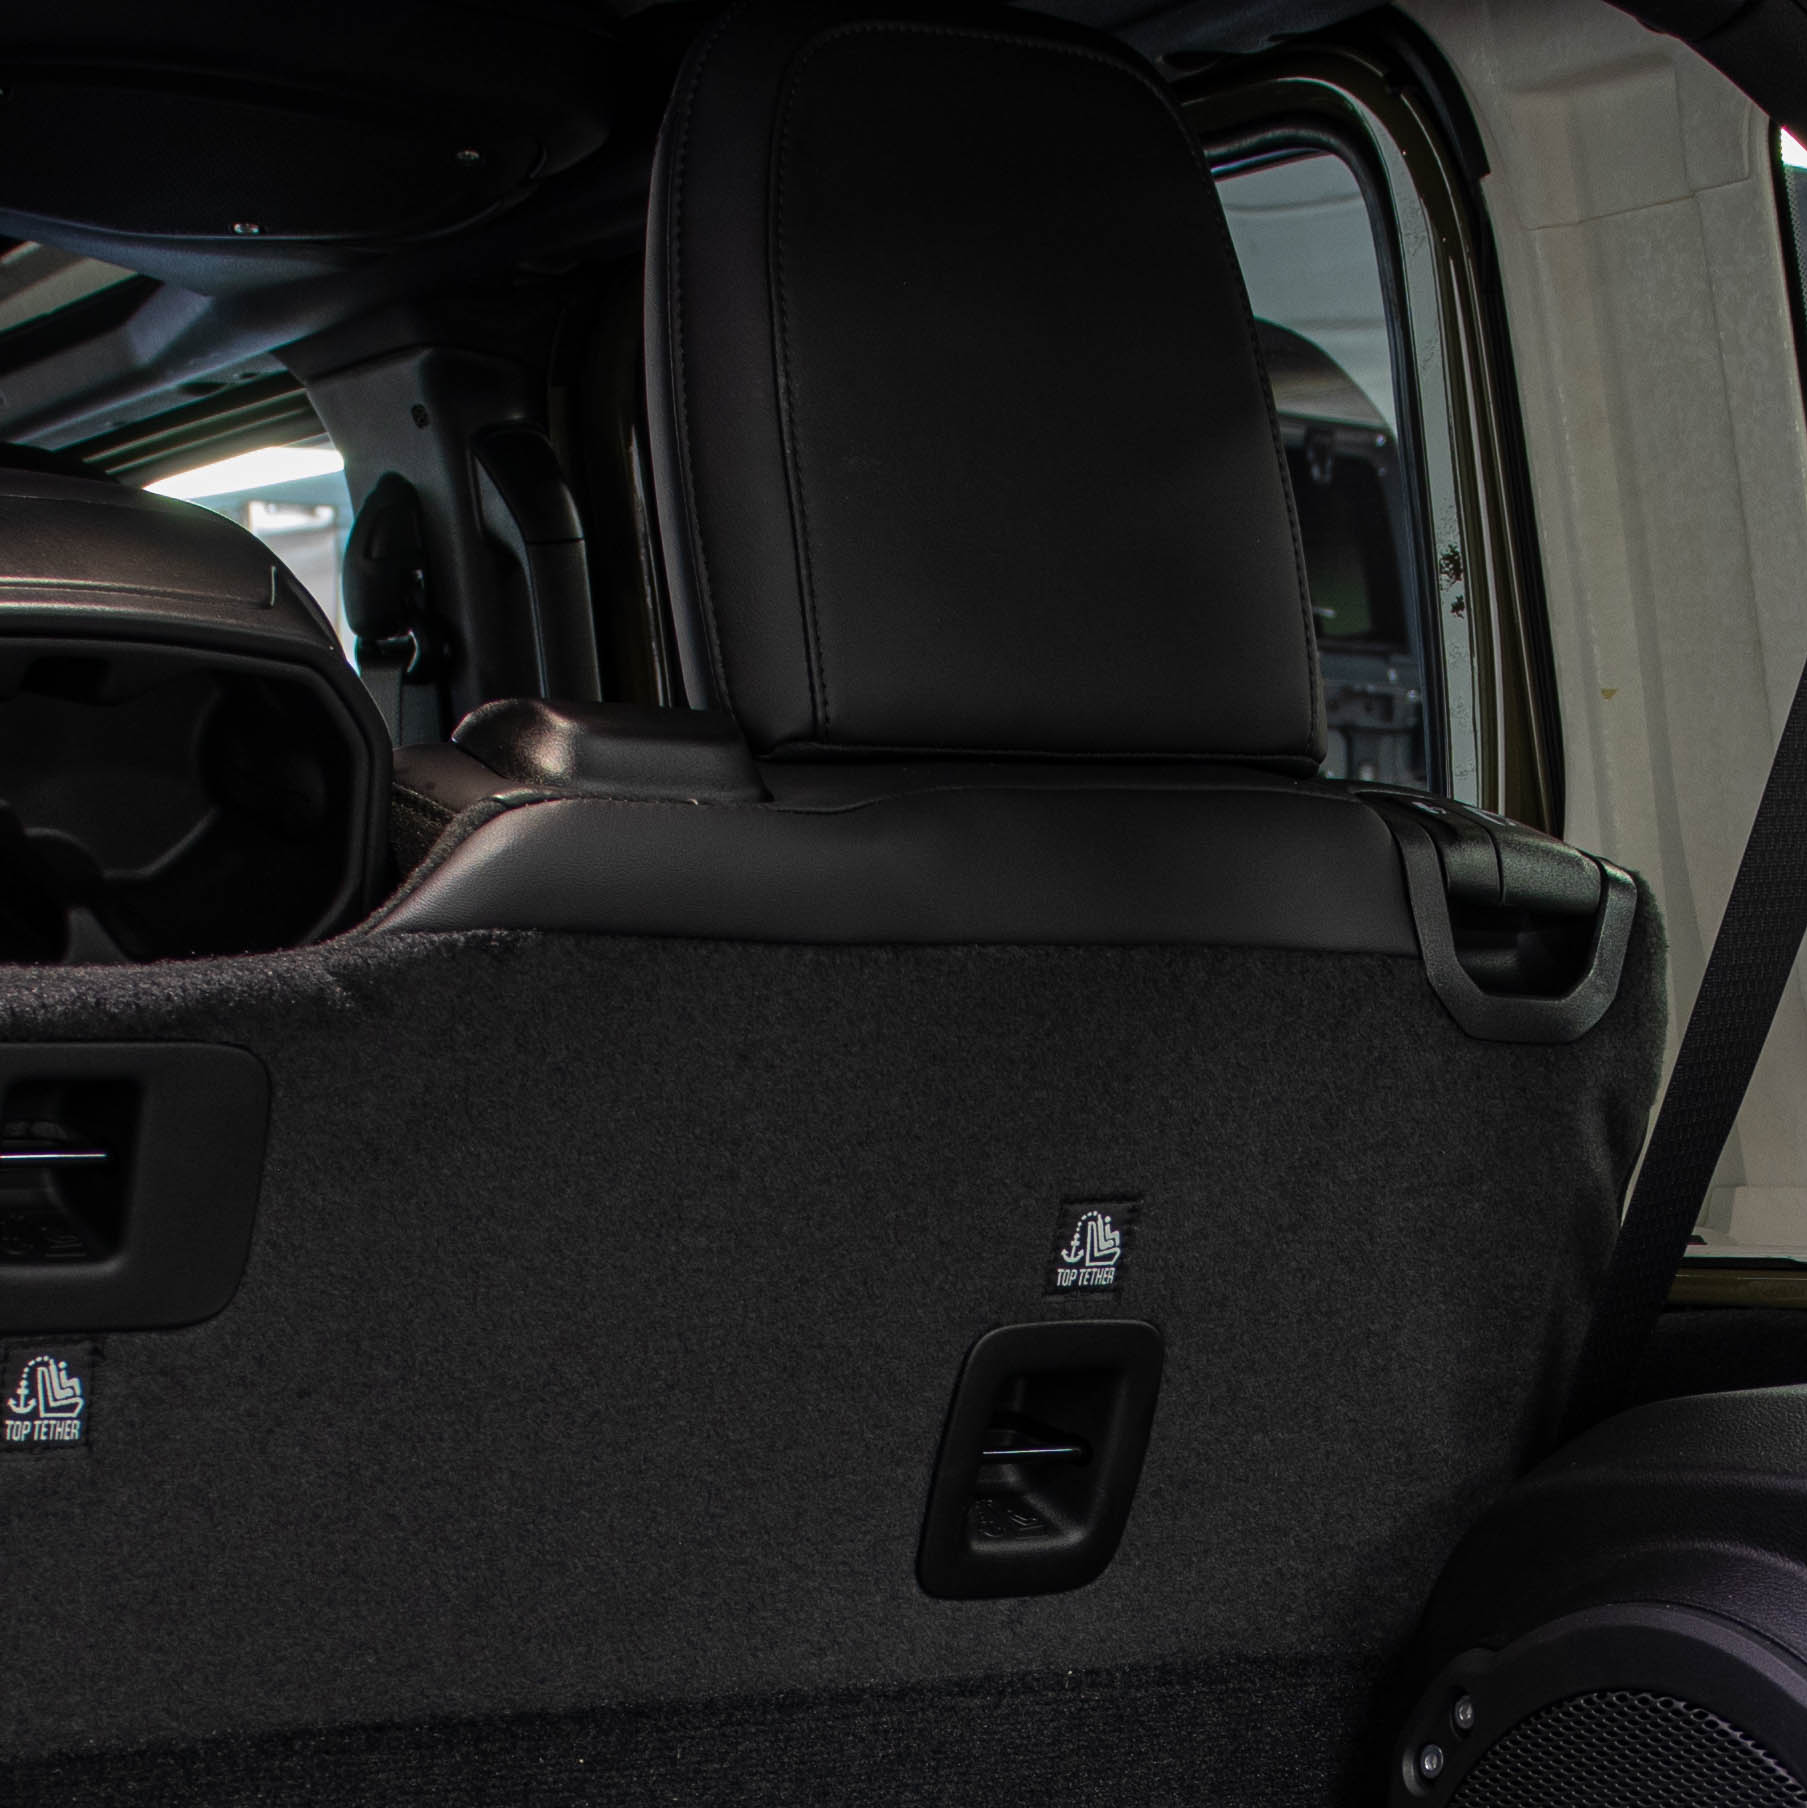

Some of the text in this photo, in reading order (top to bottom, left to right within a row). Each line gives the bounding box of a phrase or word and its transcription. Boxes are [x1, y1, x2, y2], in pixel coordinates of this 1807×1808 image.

[1057, 1267, 1116, 1286] TOP TETHER
[4, 1420, 81, 1441] TOP TETHER
